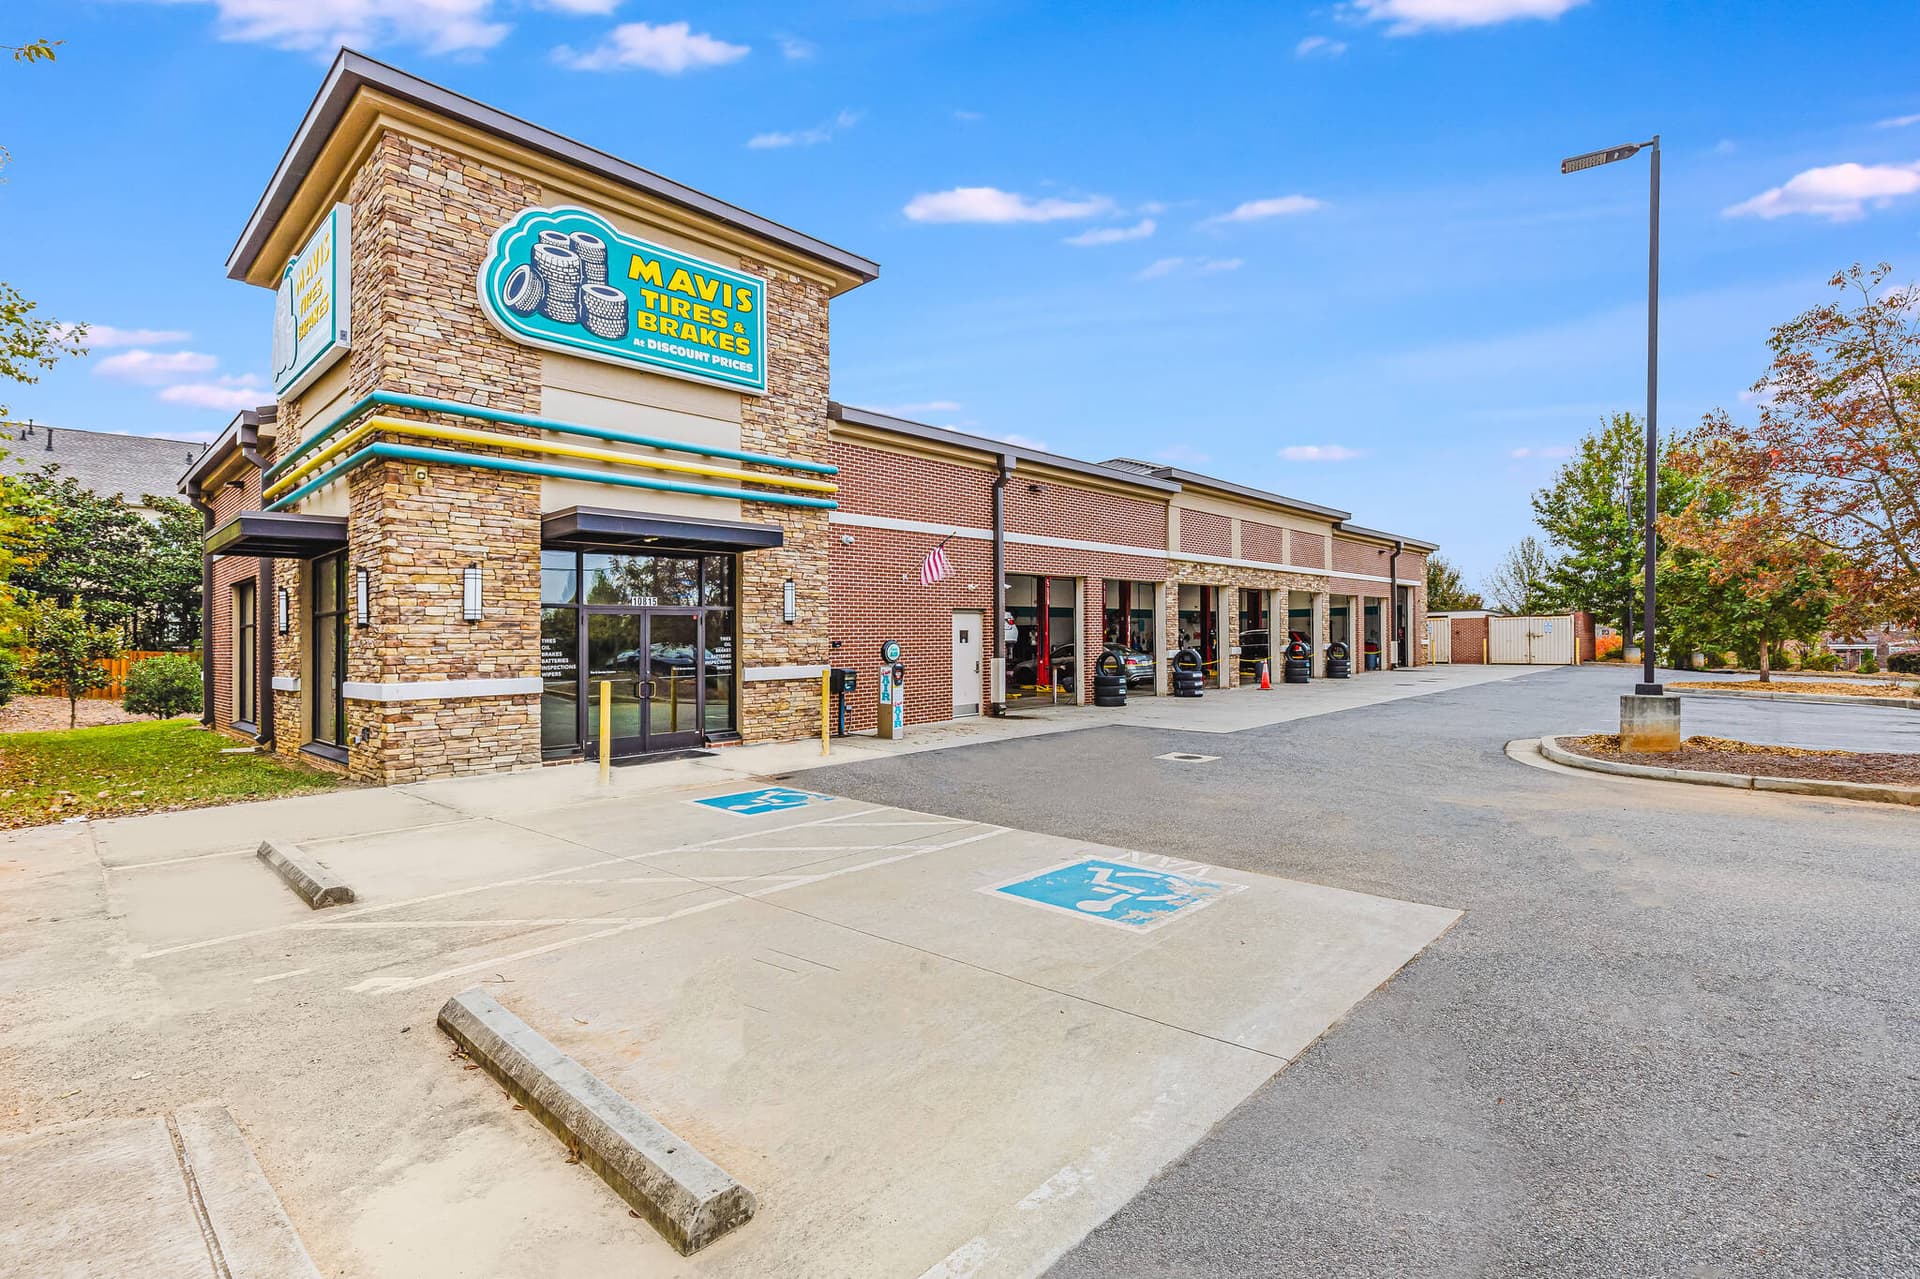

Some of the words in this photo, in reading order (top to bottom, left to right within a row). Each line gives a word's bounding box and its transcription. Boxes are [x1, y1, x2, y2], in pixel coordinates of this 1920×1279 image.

[296, 233, 330, 296] MAVIS
[628, 254, 753, 312] MAVIS
[636, 308, 751, 356] BRAKES
[640, 287, 728, 328] TIRES
[733, 321, 745, 335] &
[633, 337, 645, 347] At
[647, 339, 710, 363] DISCOUNT
[711, 355, 754, 373] PRICES
[633, 597, 657, 606] 10815
[881, 675, 890, 701] AIR
[894, 706, 902, 728] AIR
